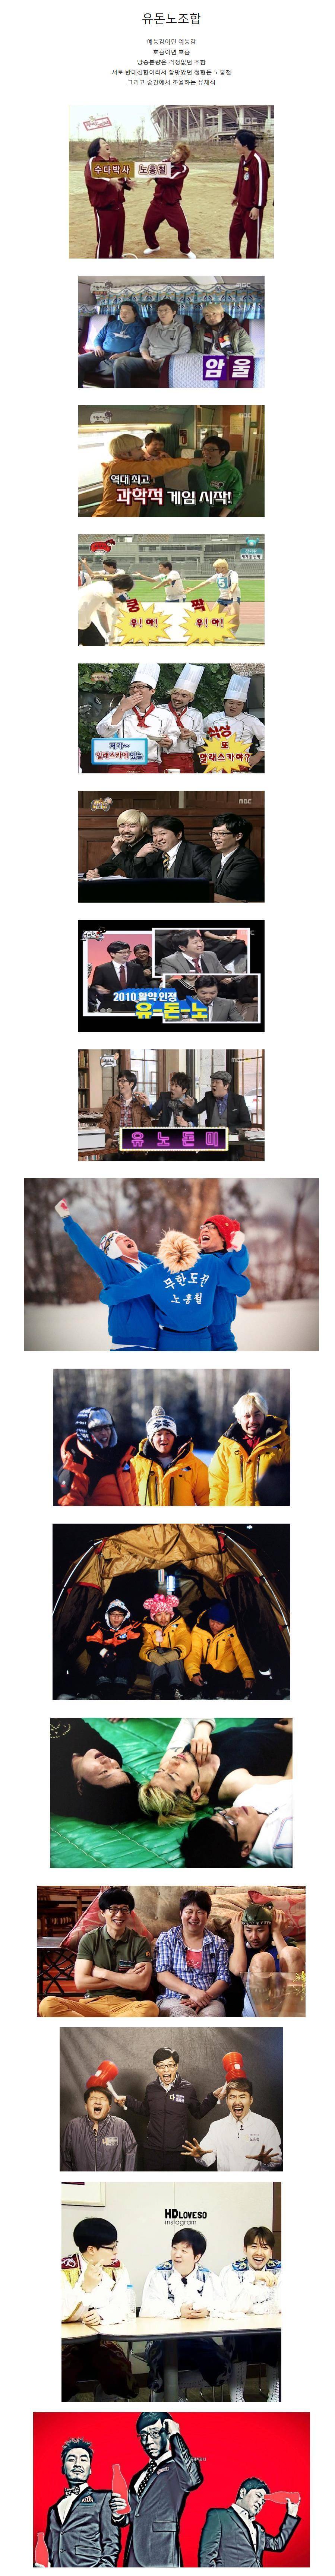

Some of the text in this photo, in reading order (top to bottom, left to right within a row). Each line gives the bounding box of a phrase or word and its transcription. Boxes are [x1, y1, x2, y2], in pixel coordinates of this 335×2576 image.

[218, 579, 225, 587] 5
[163, 1273, 209, 1289] 무한도전
[171, 1293, 202, 1304] 노홍철
